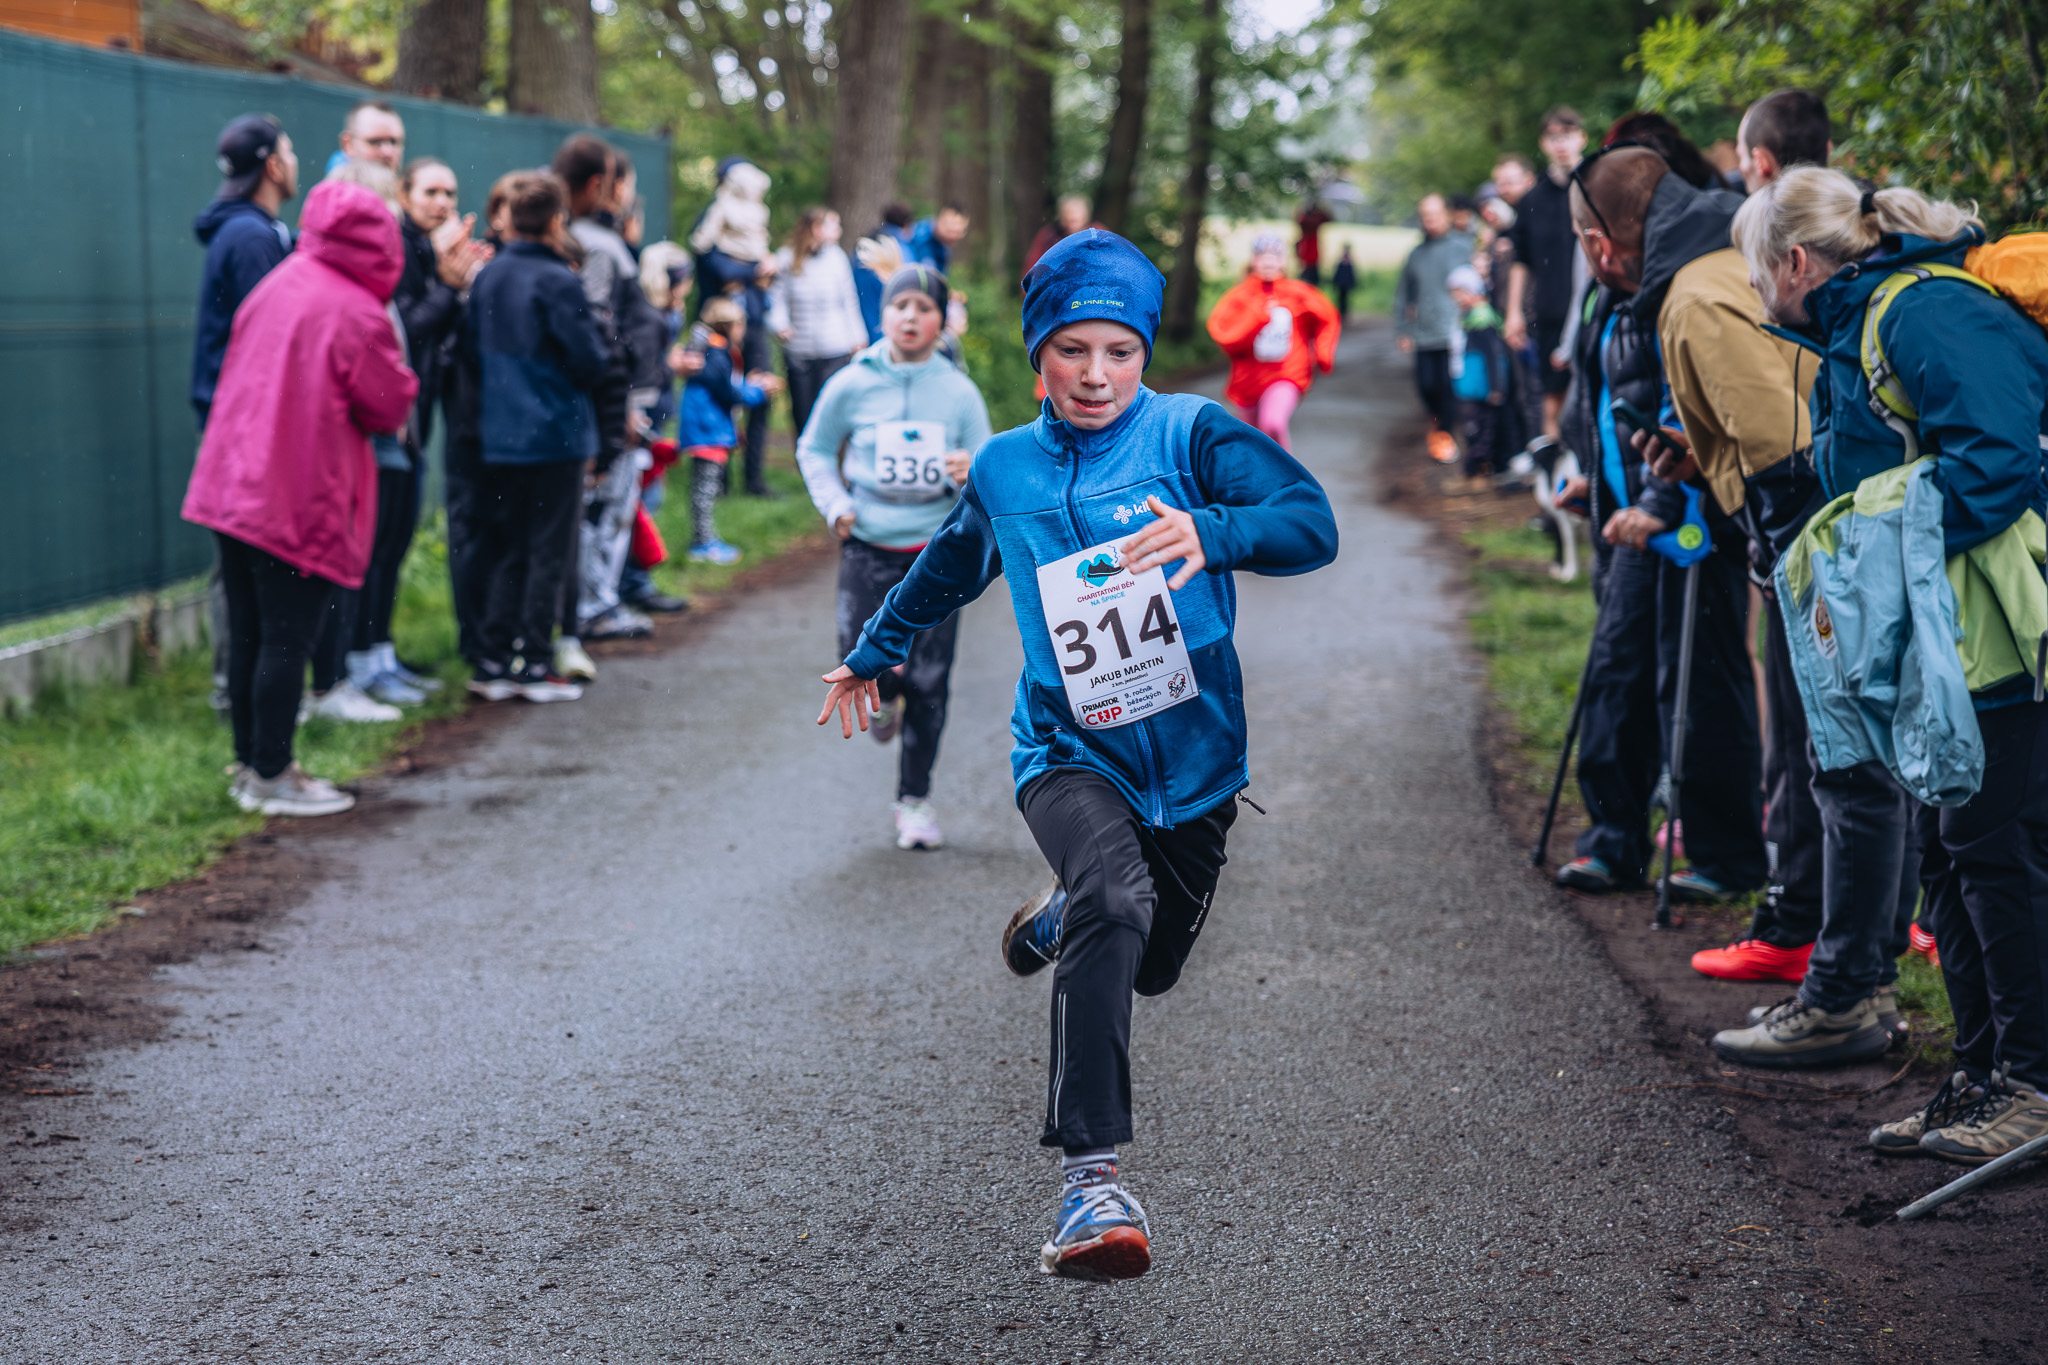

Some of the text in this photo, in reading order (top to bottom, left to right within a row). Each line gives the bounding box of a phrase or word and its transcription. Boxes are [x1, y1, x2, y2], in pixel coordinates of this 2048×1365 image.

[880, 456, 941, 484] 336
[1133, 497, 1160, 515] kil
[1077, 581, 1135, 602] CHARITATIVNÍ BĚH
[1053, 593, 1179, 675] 314
[1090, 670, 1122, 688] JAKUB
[1124, 656, 1164, 676] MARTIN
[1127, 690, 1161, 706] běžeckých
[1132, 685, 1153, 696] ročník
[1082, 697, 1119, 714] PRIMATOR
[1129, 701, 1153, 714] závodů
[1086, 706, 1122, 725] CUP
